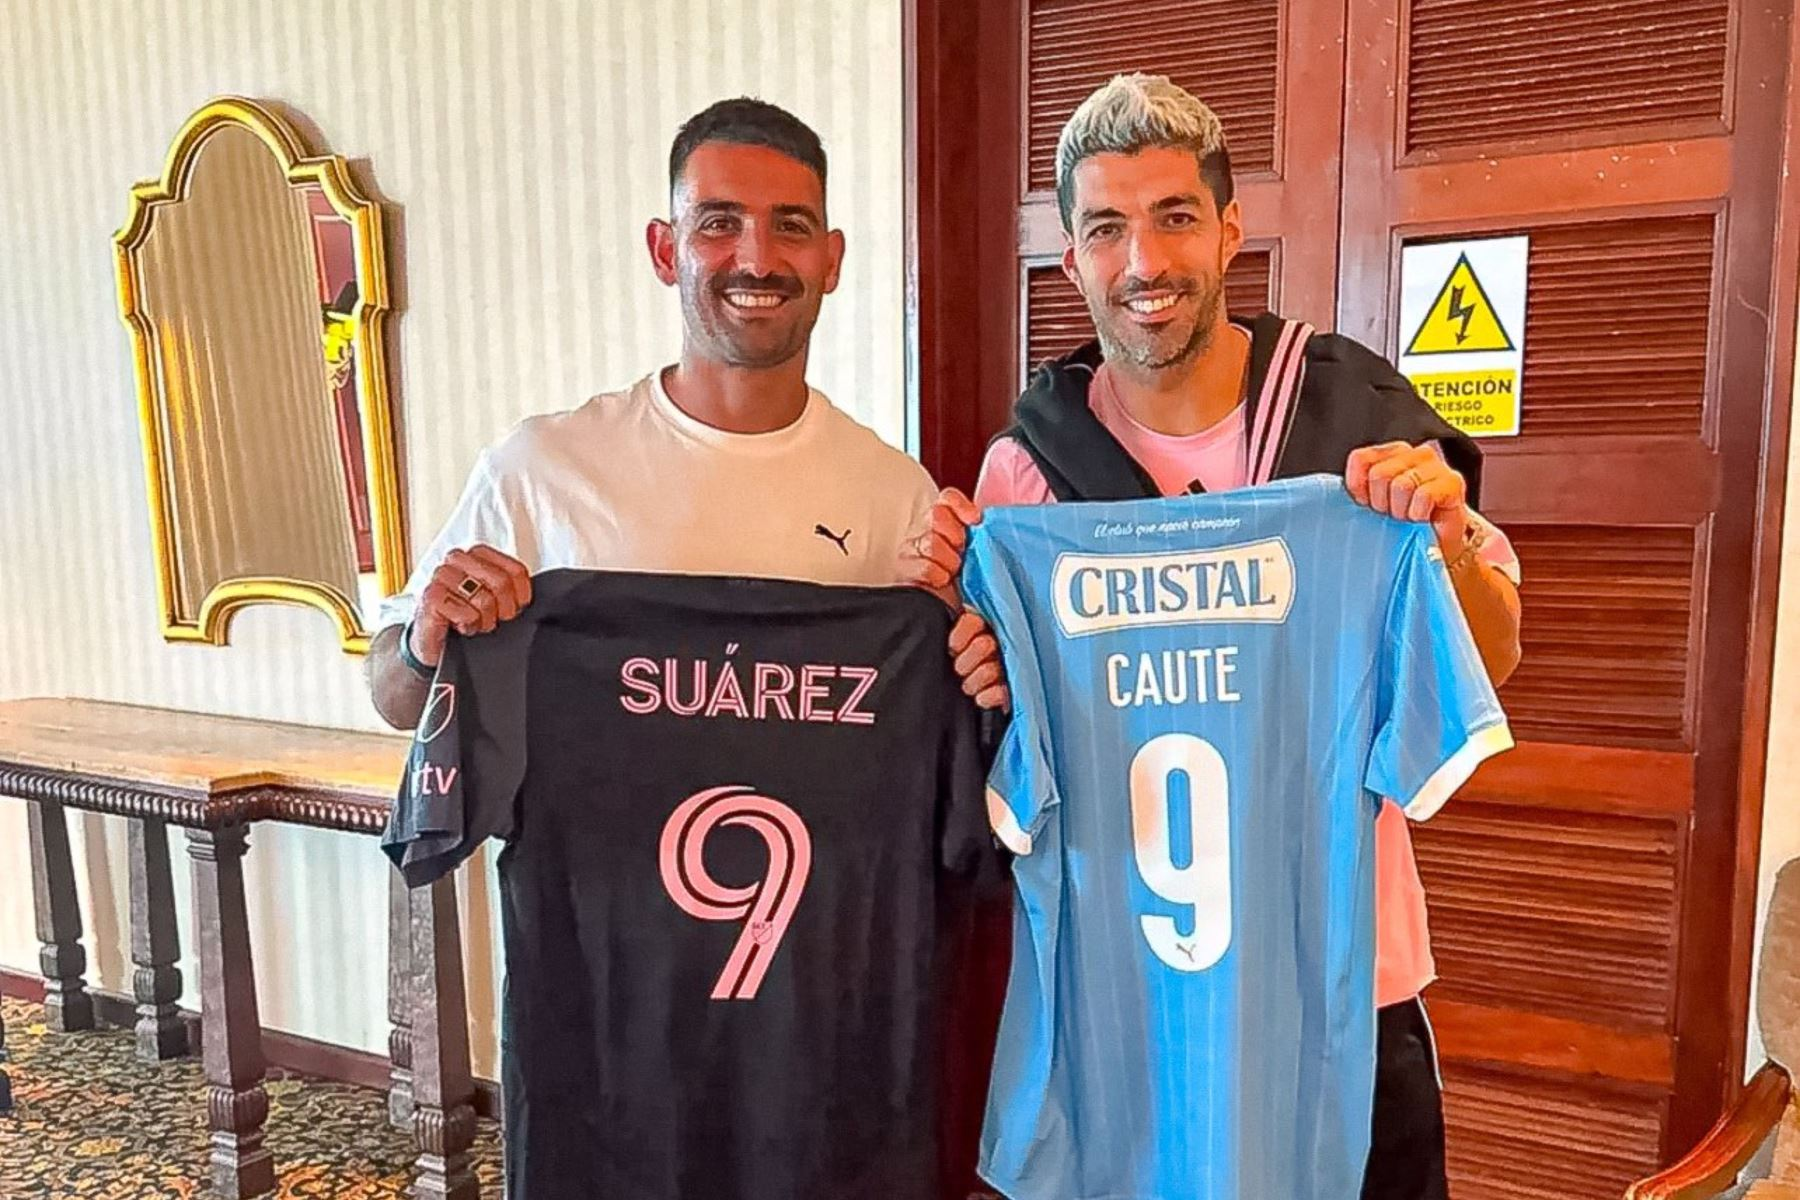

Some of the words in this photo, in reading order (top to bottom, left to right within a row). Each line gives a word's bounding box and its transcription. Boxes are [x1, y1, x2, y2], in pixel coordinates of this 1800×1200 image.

[1435, 400, 1482, 412] RIESGO
[1070, 558, 1276, 618] CRISTAL
[620, 643, 878, 724] SUÁREZ
[1107, 646, 1241, 708] CAUTE
[1130, 733, 1231, 972] 9
[659, 785, 812, 999] 9
